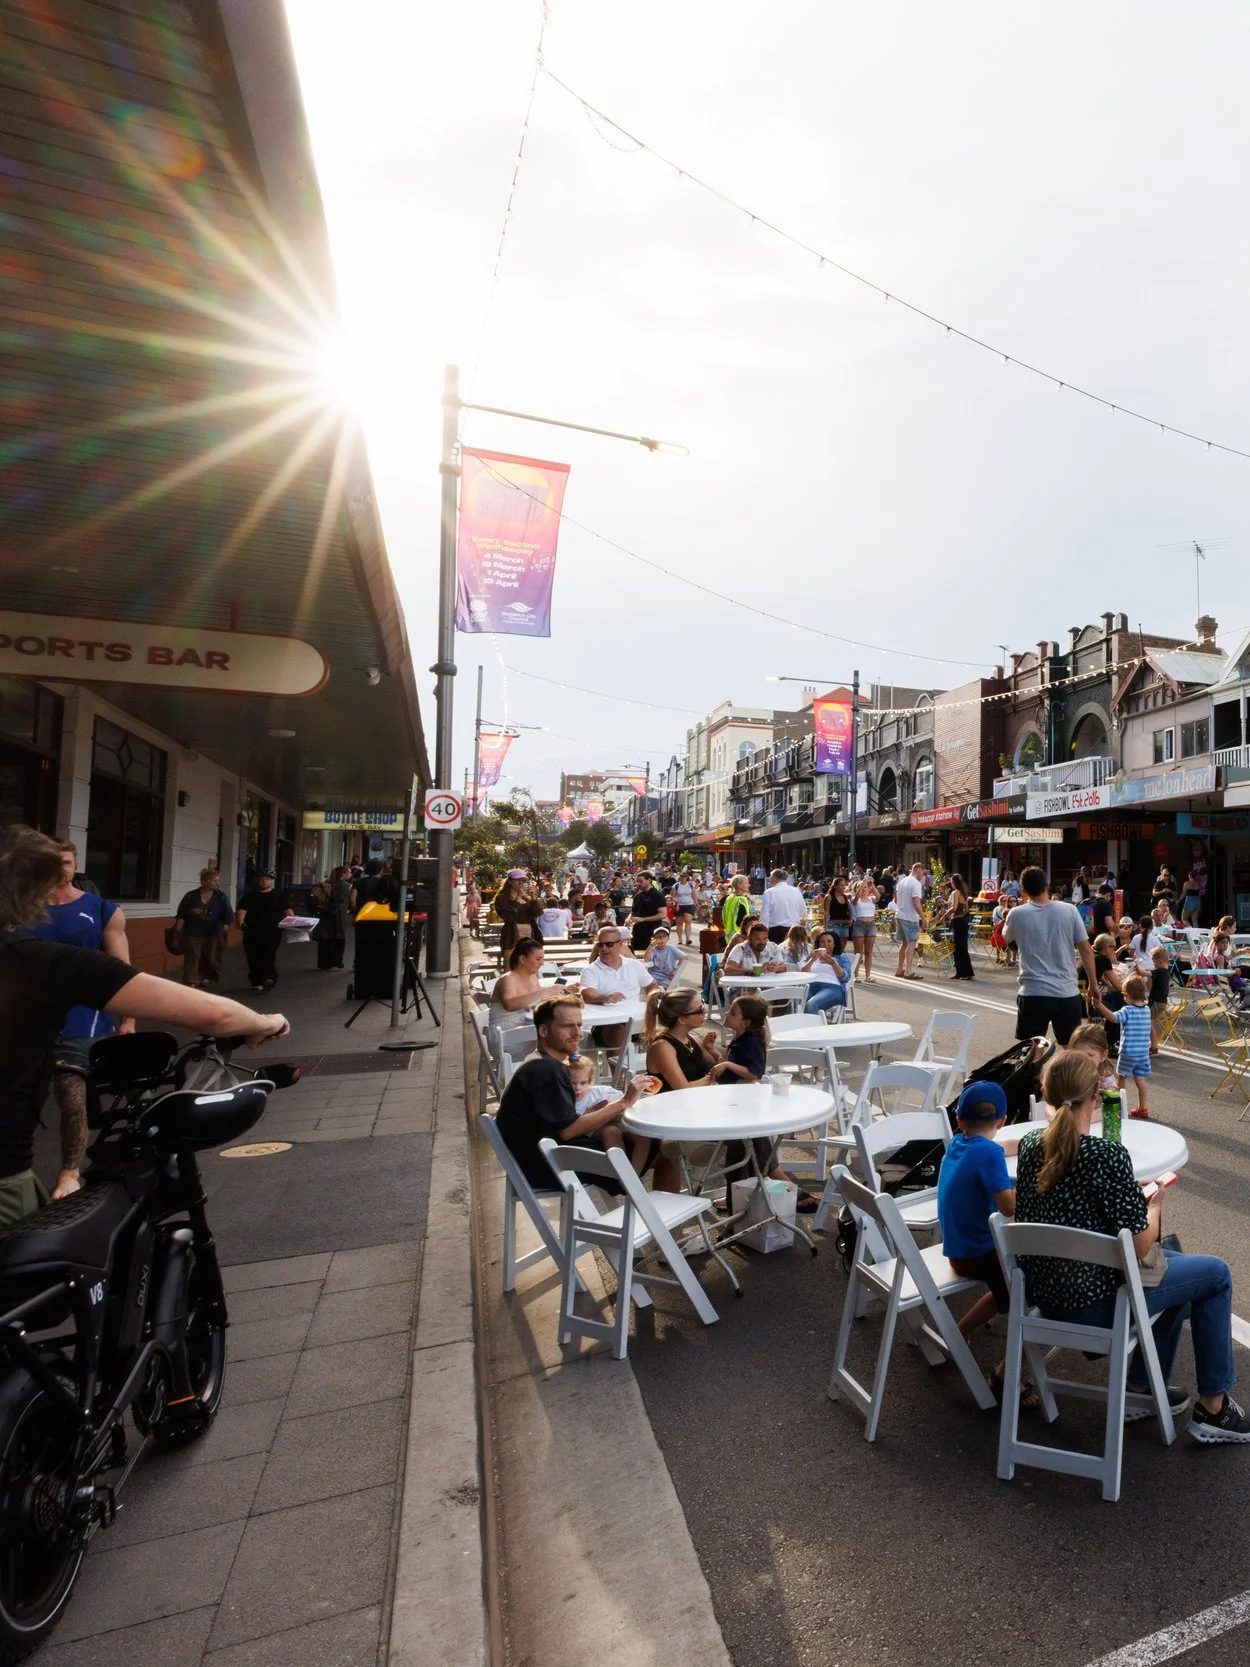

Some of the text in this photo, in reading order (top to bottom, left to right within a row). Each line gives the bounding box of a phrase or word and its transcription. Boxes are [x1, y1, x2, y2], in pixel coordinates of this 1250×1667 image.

[492, 553, 524, 564] March
[493, 561, 525, 572] March
[493, 570, 517, 579] April
[495, 579, 519, 588] April
[146, 645, 230, 671] BAR
[1144, 766, 1212, 798] melonhead
[430, 802, 456, 816] 40
[1043, 795, 1071, 813] FISHBOWL
[323, 811, 398, 825] BOTTLE SHOP
[1007, 828, 1064, 838] GetSashimi
[1089, 823, 1144, 839] FISHBOWL
[136, 1264, 150, 1307] OUXI
[89, 1281, 104, 1306] V8
